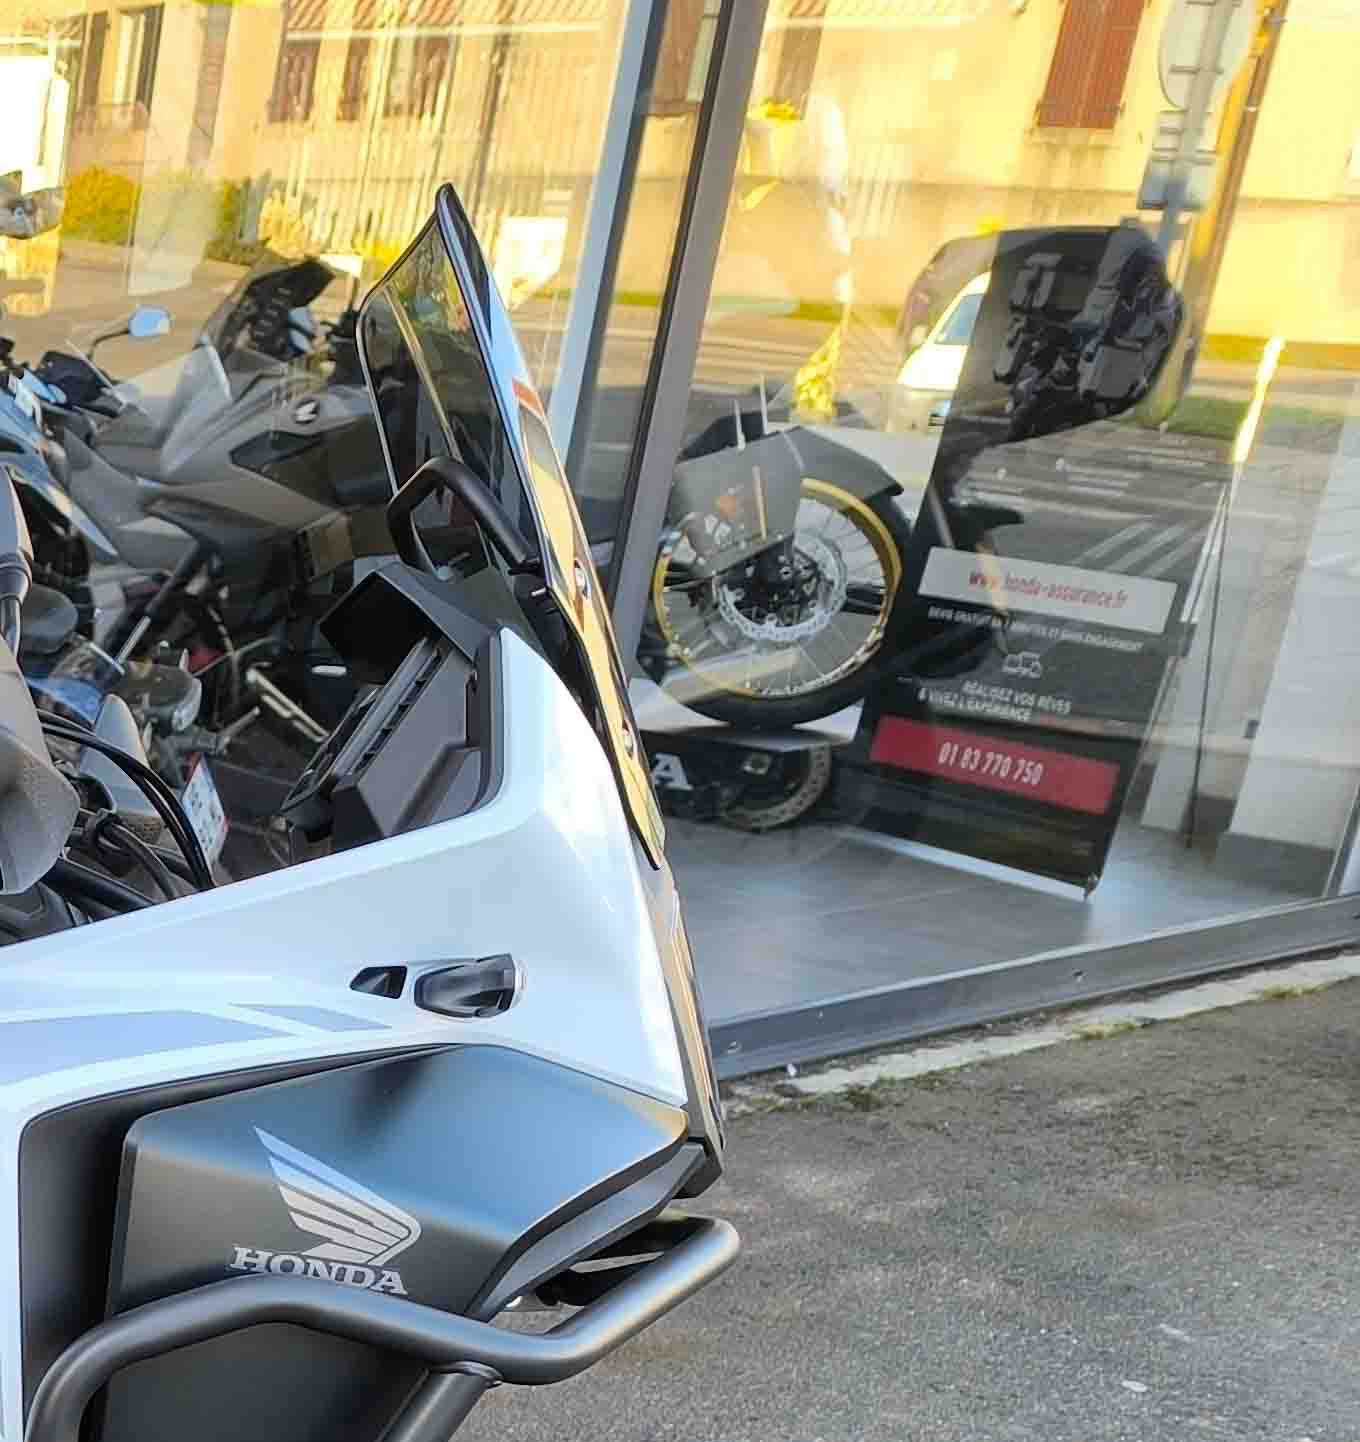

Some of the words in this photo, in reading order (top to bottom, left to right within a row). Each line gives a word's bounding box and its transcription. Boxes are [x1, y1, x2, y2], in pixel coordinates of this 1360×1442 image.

[937, 741, 958, 766] 01
[960, 745, 980, 773] 83
[228, 1244, 409, 1295] HONDA
